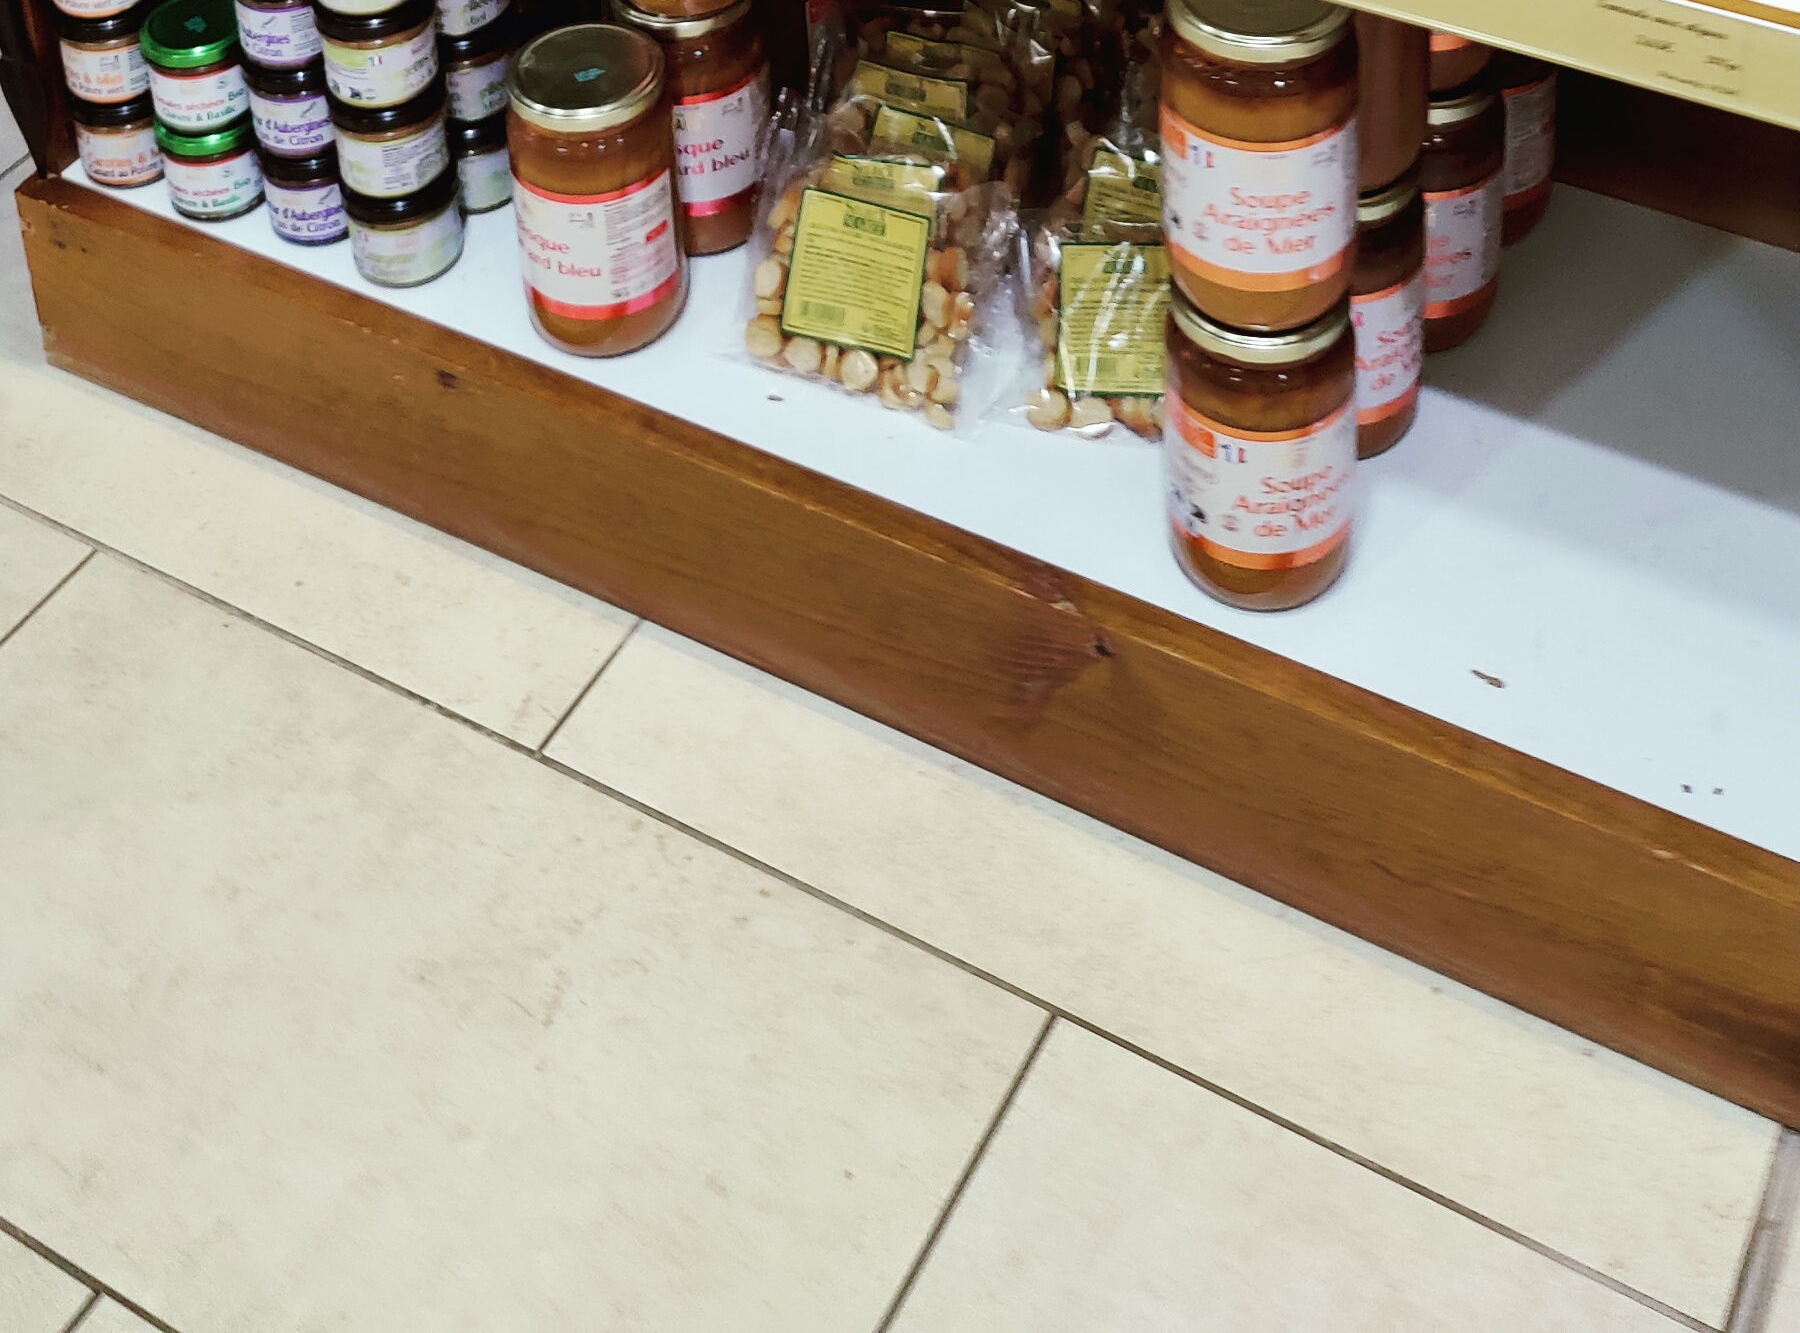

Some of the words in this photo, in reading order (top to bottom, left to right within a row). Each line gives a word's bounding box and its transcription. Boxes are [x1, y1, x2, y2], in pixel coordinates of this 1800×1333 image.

[676, 137, 724, 160] sque
[711, 147, 750, 174] bleu
[1229, 186, 1313, 214] Soupe
[1203, 201, 1337, 237] Araignées
[1222, 232, 1257, 255] de
[1264, 234, 1317, 255] Mer
[557, 260, 603, 278] bleu
[1259, 464, 1335, 495] Soupe
[1253, 519, 1289, 538] de
